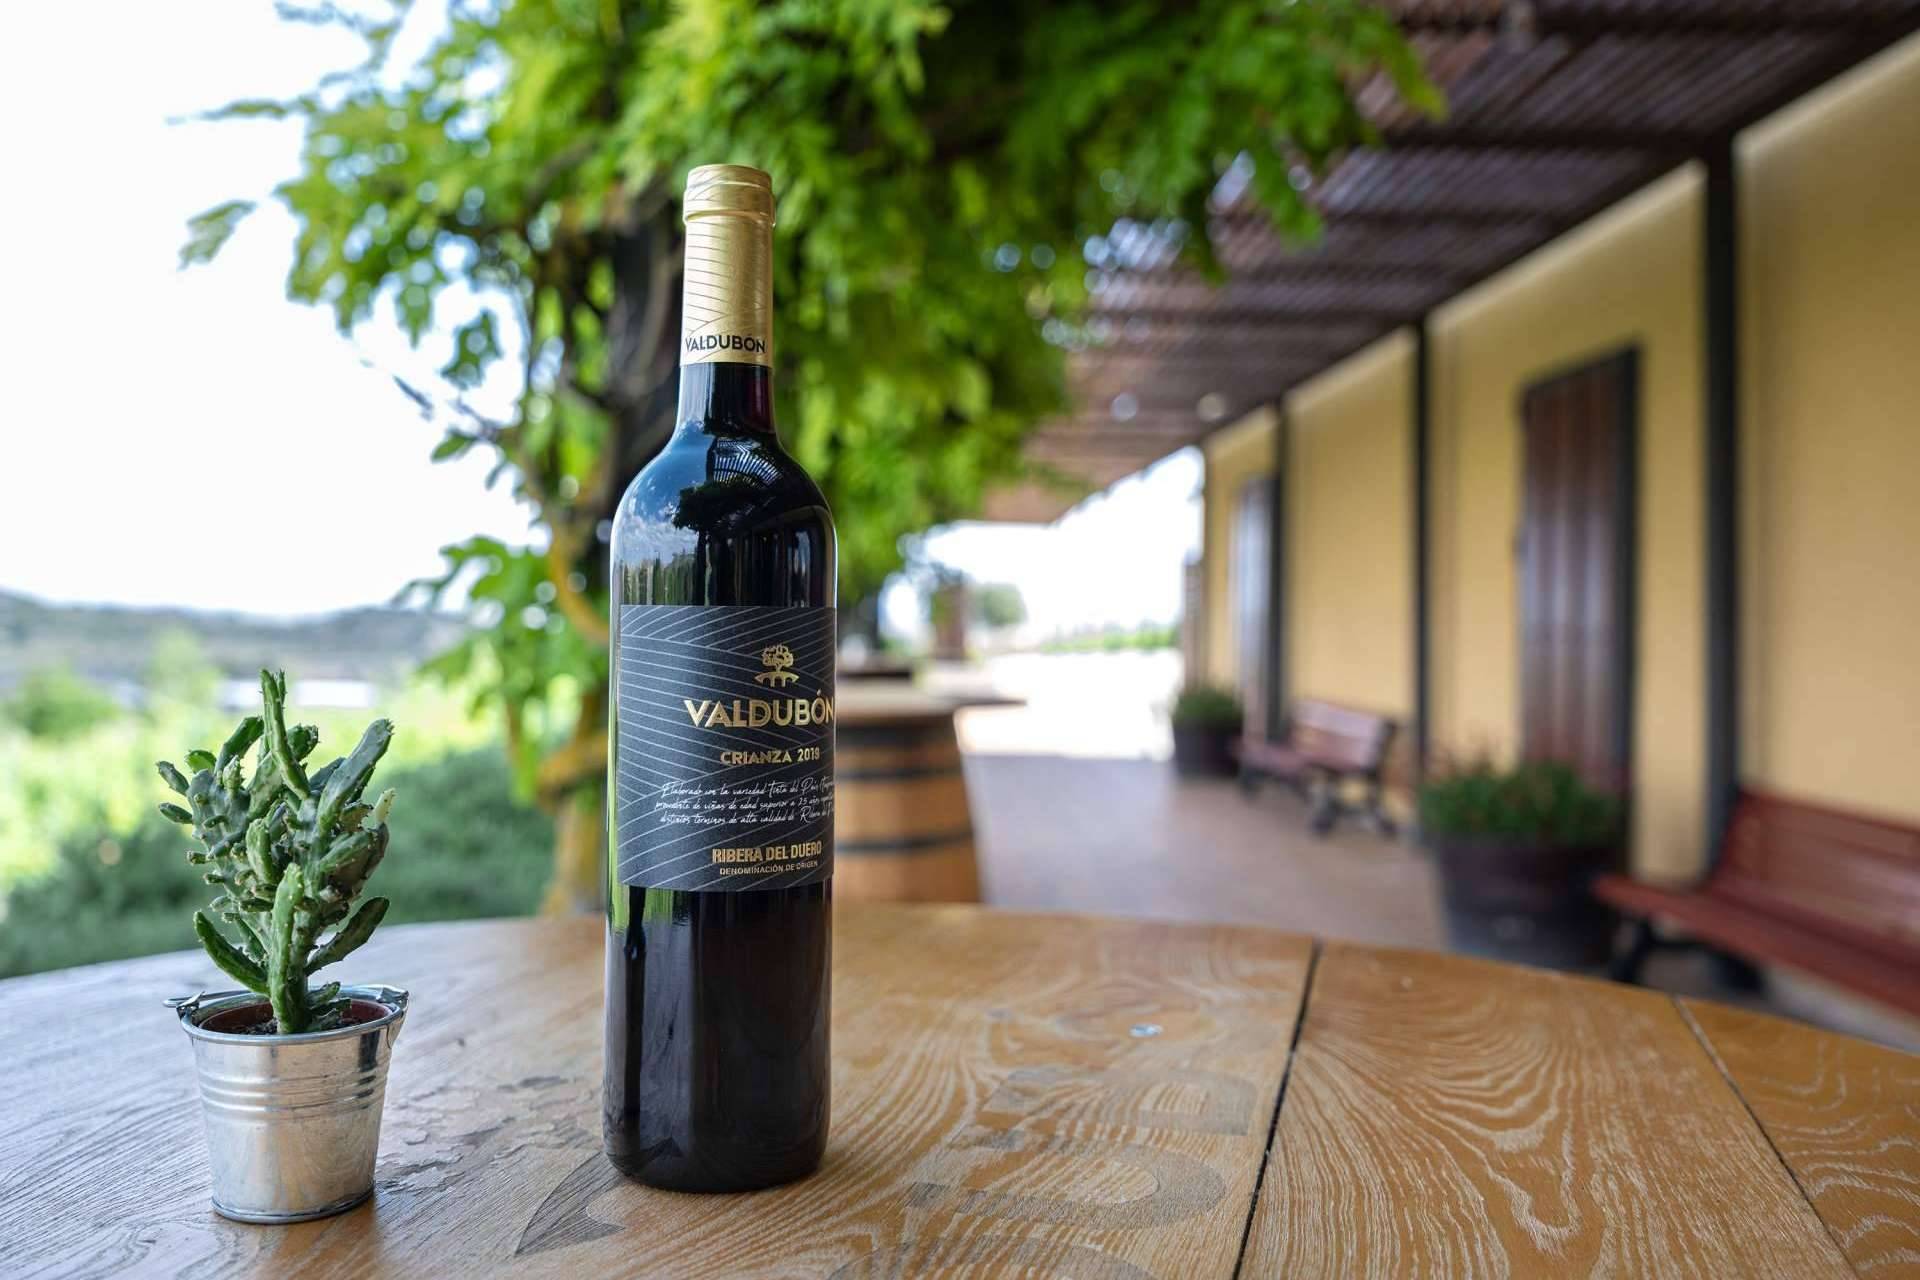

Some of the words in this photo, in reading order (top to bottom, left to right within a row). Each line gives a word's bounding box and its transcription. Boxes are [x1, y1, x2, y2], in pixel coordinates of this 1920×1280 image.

[685, 333, 766, 353] VALDUBÓN
[684, 689, 834, 728] VALDUBÓN
[720, 750, 792, 765] CRIANZA
[797, 747, 820, 762] 2019
[712, 848, 763, 864] RIBERA
[766, 845, 789, 861] DEL
[791, 841, 822, 859] DUERO
[720, 864, 784, 876] DENOMINACIÓN
[786, 863, 795, 871] DE
